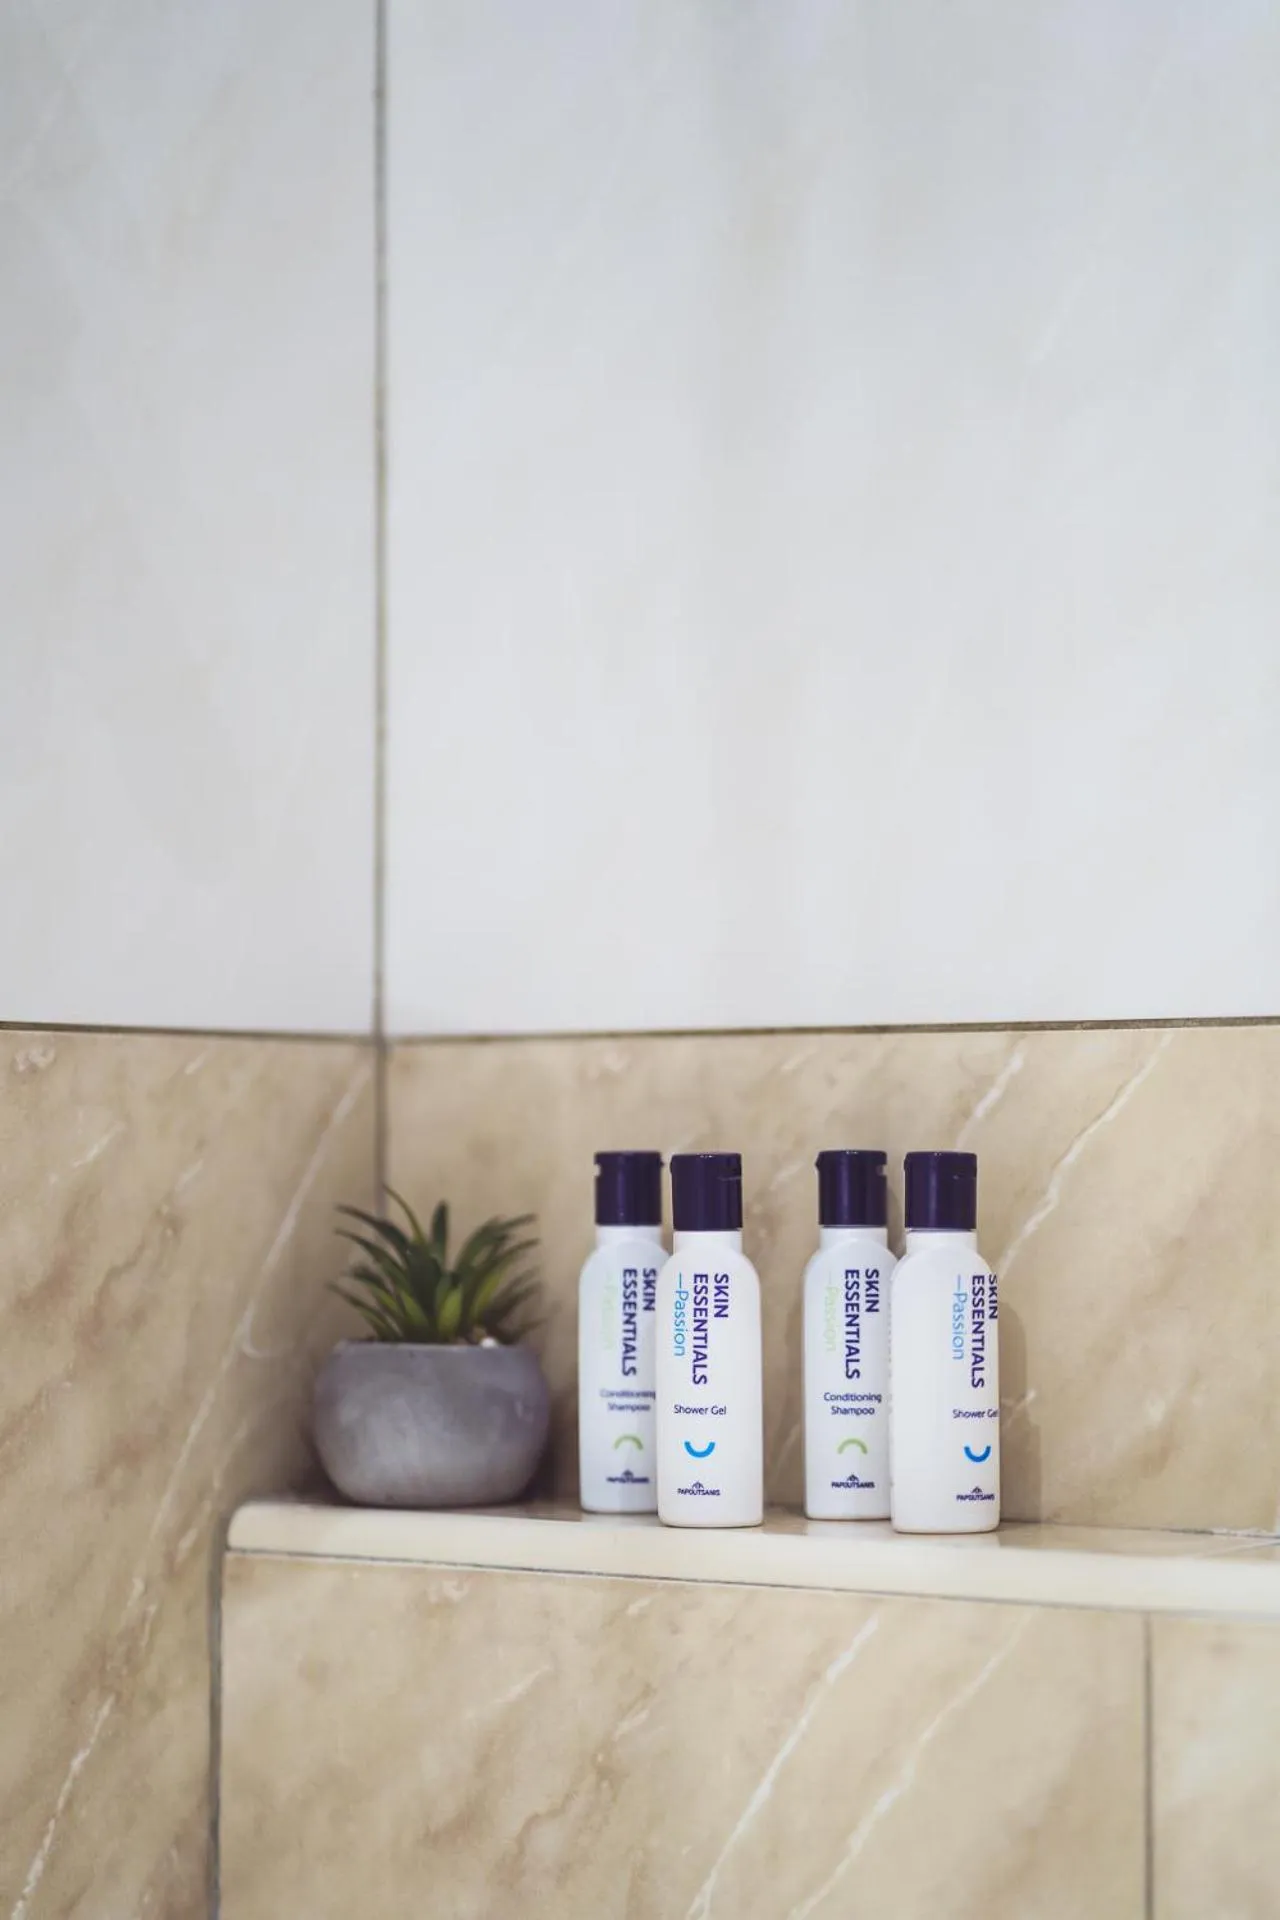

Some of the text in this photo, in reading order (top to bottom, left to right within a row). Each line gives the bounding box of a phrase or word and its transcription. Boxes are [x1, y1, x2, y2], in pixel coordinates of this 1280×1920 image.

[642, 1267, 657, 1312] SKIN
[713, 1272, 729, 1319] SKIN
[865, 1268, 880, 1313] SKIN
[988, 1274, 999, 1320] SKIN
[622, 1267, 638, 1377] ESSENTIALS
[692, 1273, 709, 1386] ESSENTIALS
[844, 1269, 861, 1380] ESSENTIALS
[971, 1274, 986, 1389] ESSENTIALS
[673, 1404, 727, 1416] Shower Gel
[823, 1392, 882, 1404] Conditioning
[831, 1406, 876, 1416] Shampoo
[952, 1408, 986, 1419] Shower
